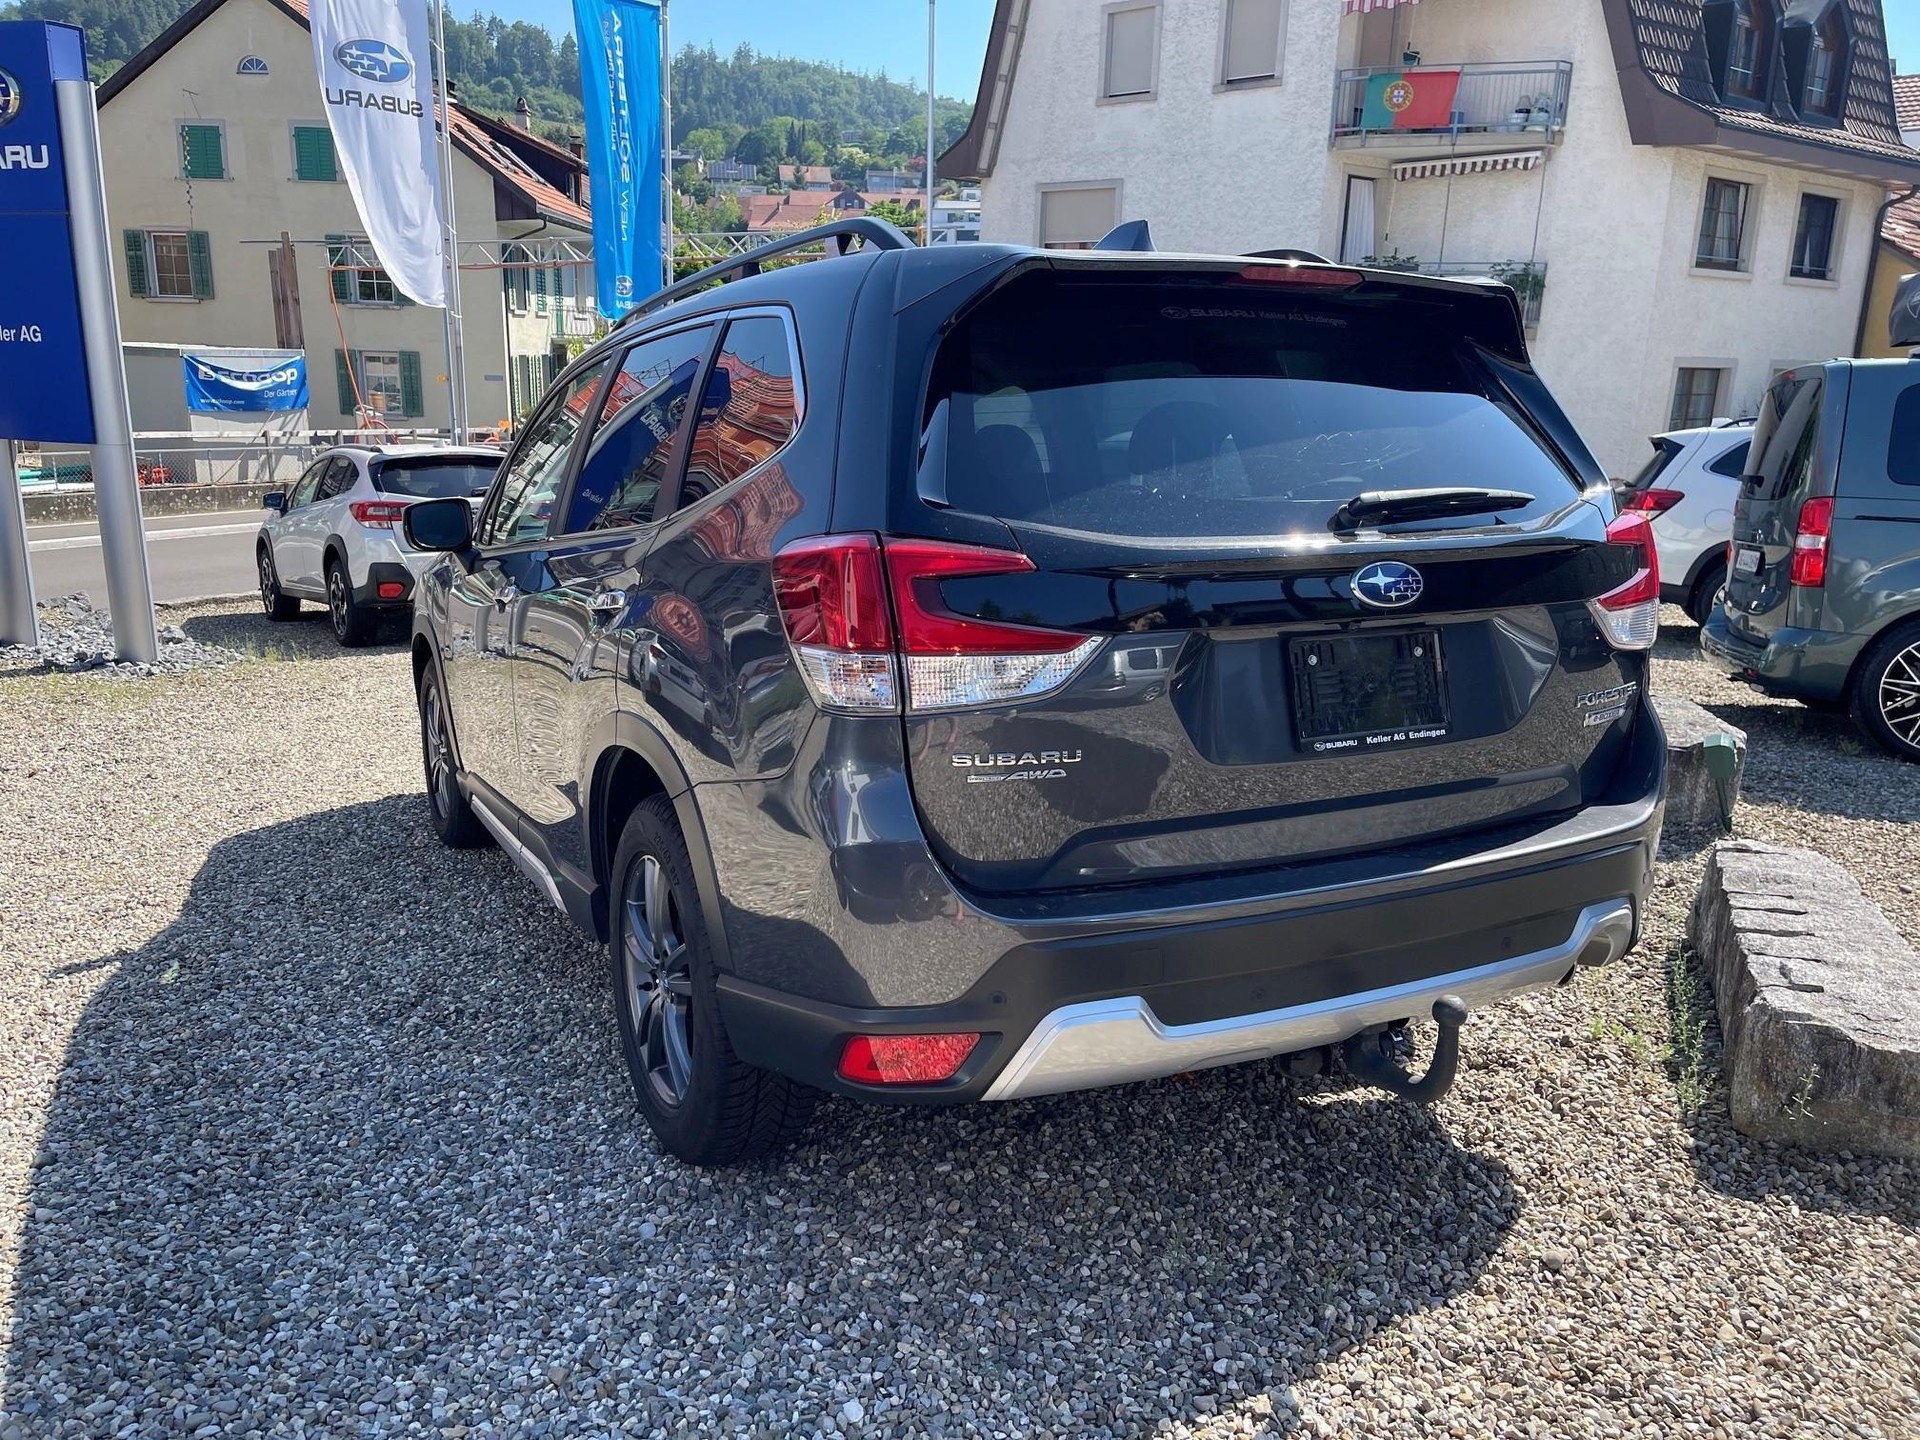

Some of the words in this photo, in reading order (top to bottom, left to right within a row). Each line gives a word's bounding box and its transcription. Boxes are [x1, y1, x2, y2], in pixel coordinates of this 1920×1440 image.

[1189, 308, 1256, 318] SUBARU
[20, 325, 42, 342] AG
[263, 389, 276, 398] Der
[1326, 740, 1358, 749] SUBARU
[1366, 735, 1391, 744] Keller
[1393, 733, 1406, 741] AG
[1408, 729, 1446, 739] Endingen
[951, 749, 1082, 767] SUBARU
[1003, 768, 1067, 781] AWD
